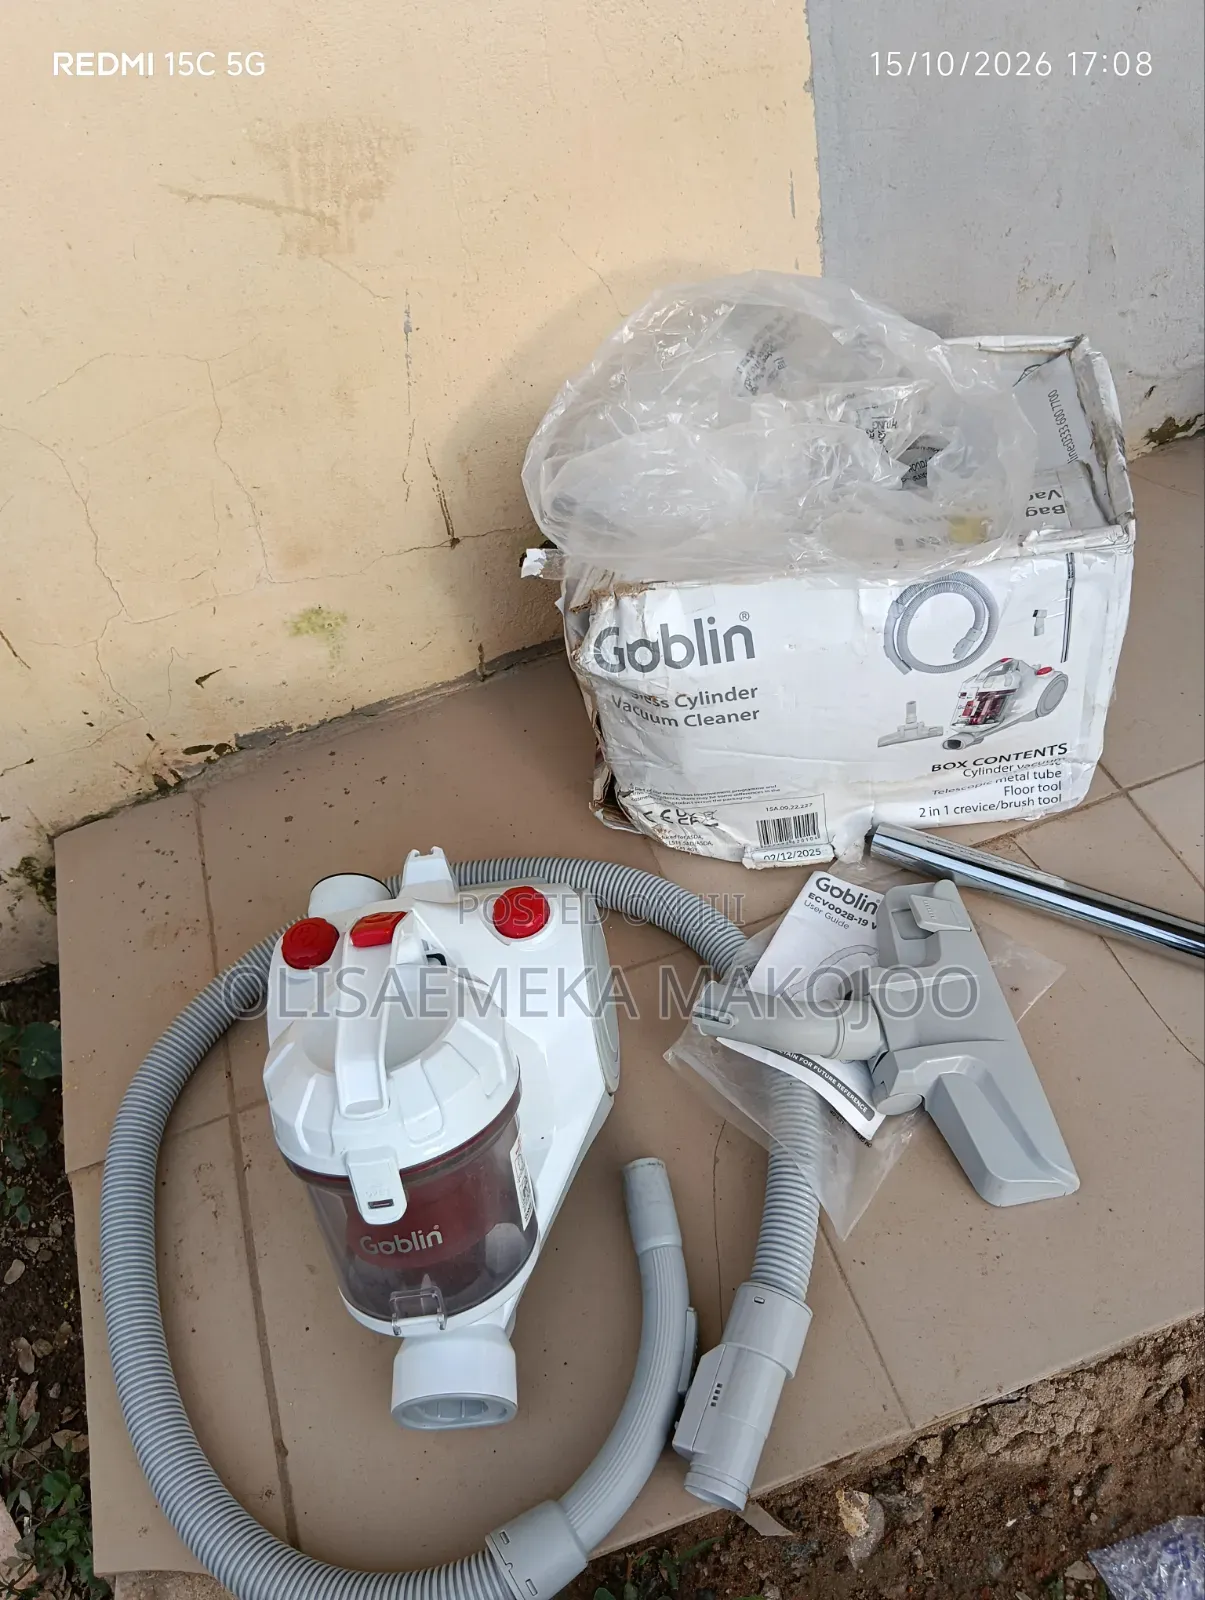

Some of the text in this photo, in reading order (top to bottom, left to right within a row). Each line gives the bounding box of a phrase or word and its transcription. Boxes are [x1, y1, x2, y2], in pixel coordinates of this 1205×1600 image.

[593, 616, 756, 674] Goblin
[611, 694, 760, 727] Vacuum Cleaner
[674, 686, 758, 710] Cylinder
[931, 742, 1068, 773] BOX CONTENTS
[963, 764, 1014, 778] Cylinder
[995, 770, 1029, 784] metal
[1033, 769, 1062, 781] tube
[1004, 781, 1062, 797] Floor tool
[919, 794, 1062, 818] 2 in 1 crevice/brush tool
[808, 892, 869, 927] ECV002B-19
[815, 877, 878, 915] Goblin
[804, 899, 850, 930] User Guide
[799, 1057, 813, 1068] FOR
[813, 1064, 836, 1085] FUTURE
[836, 1082, 868, 1113] REFERENCE
[360, 1228, 443, 1255] Goblin
